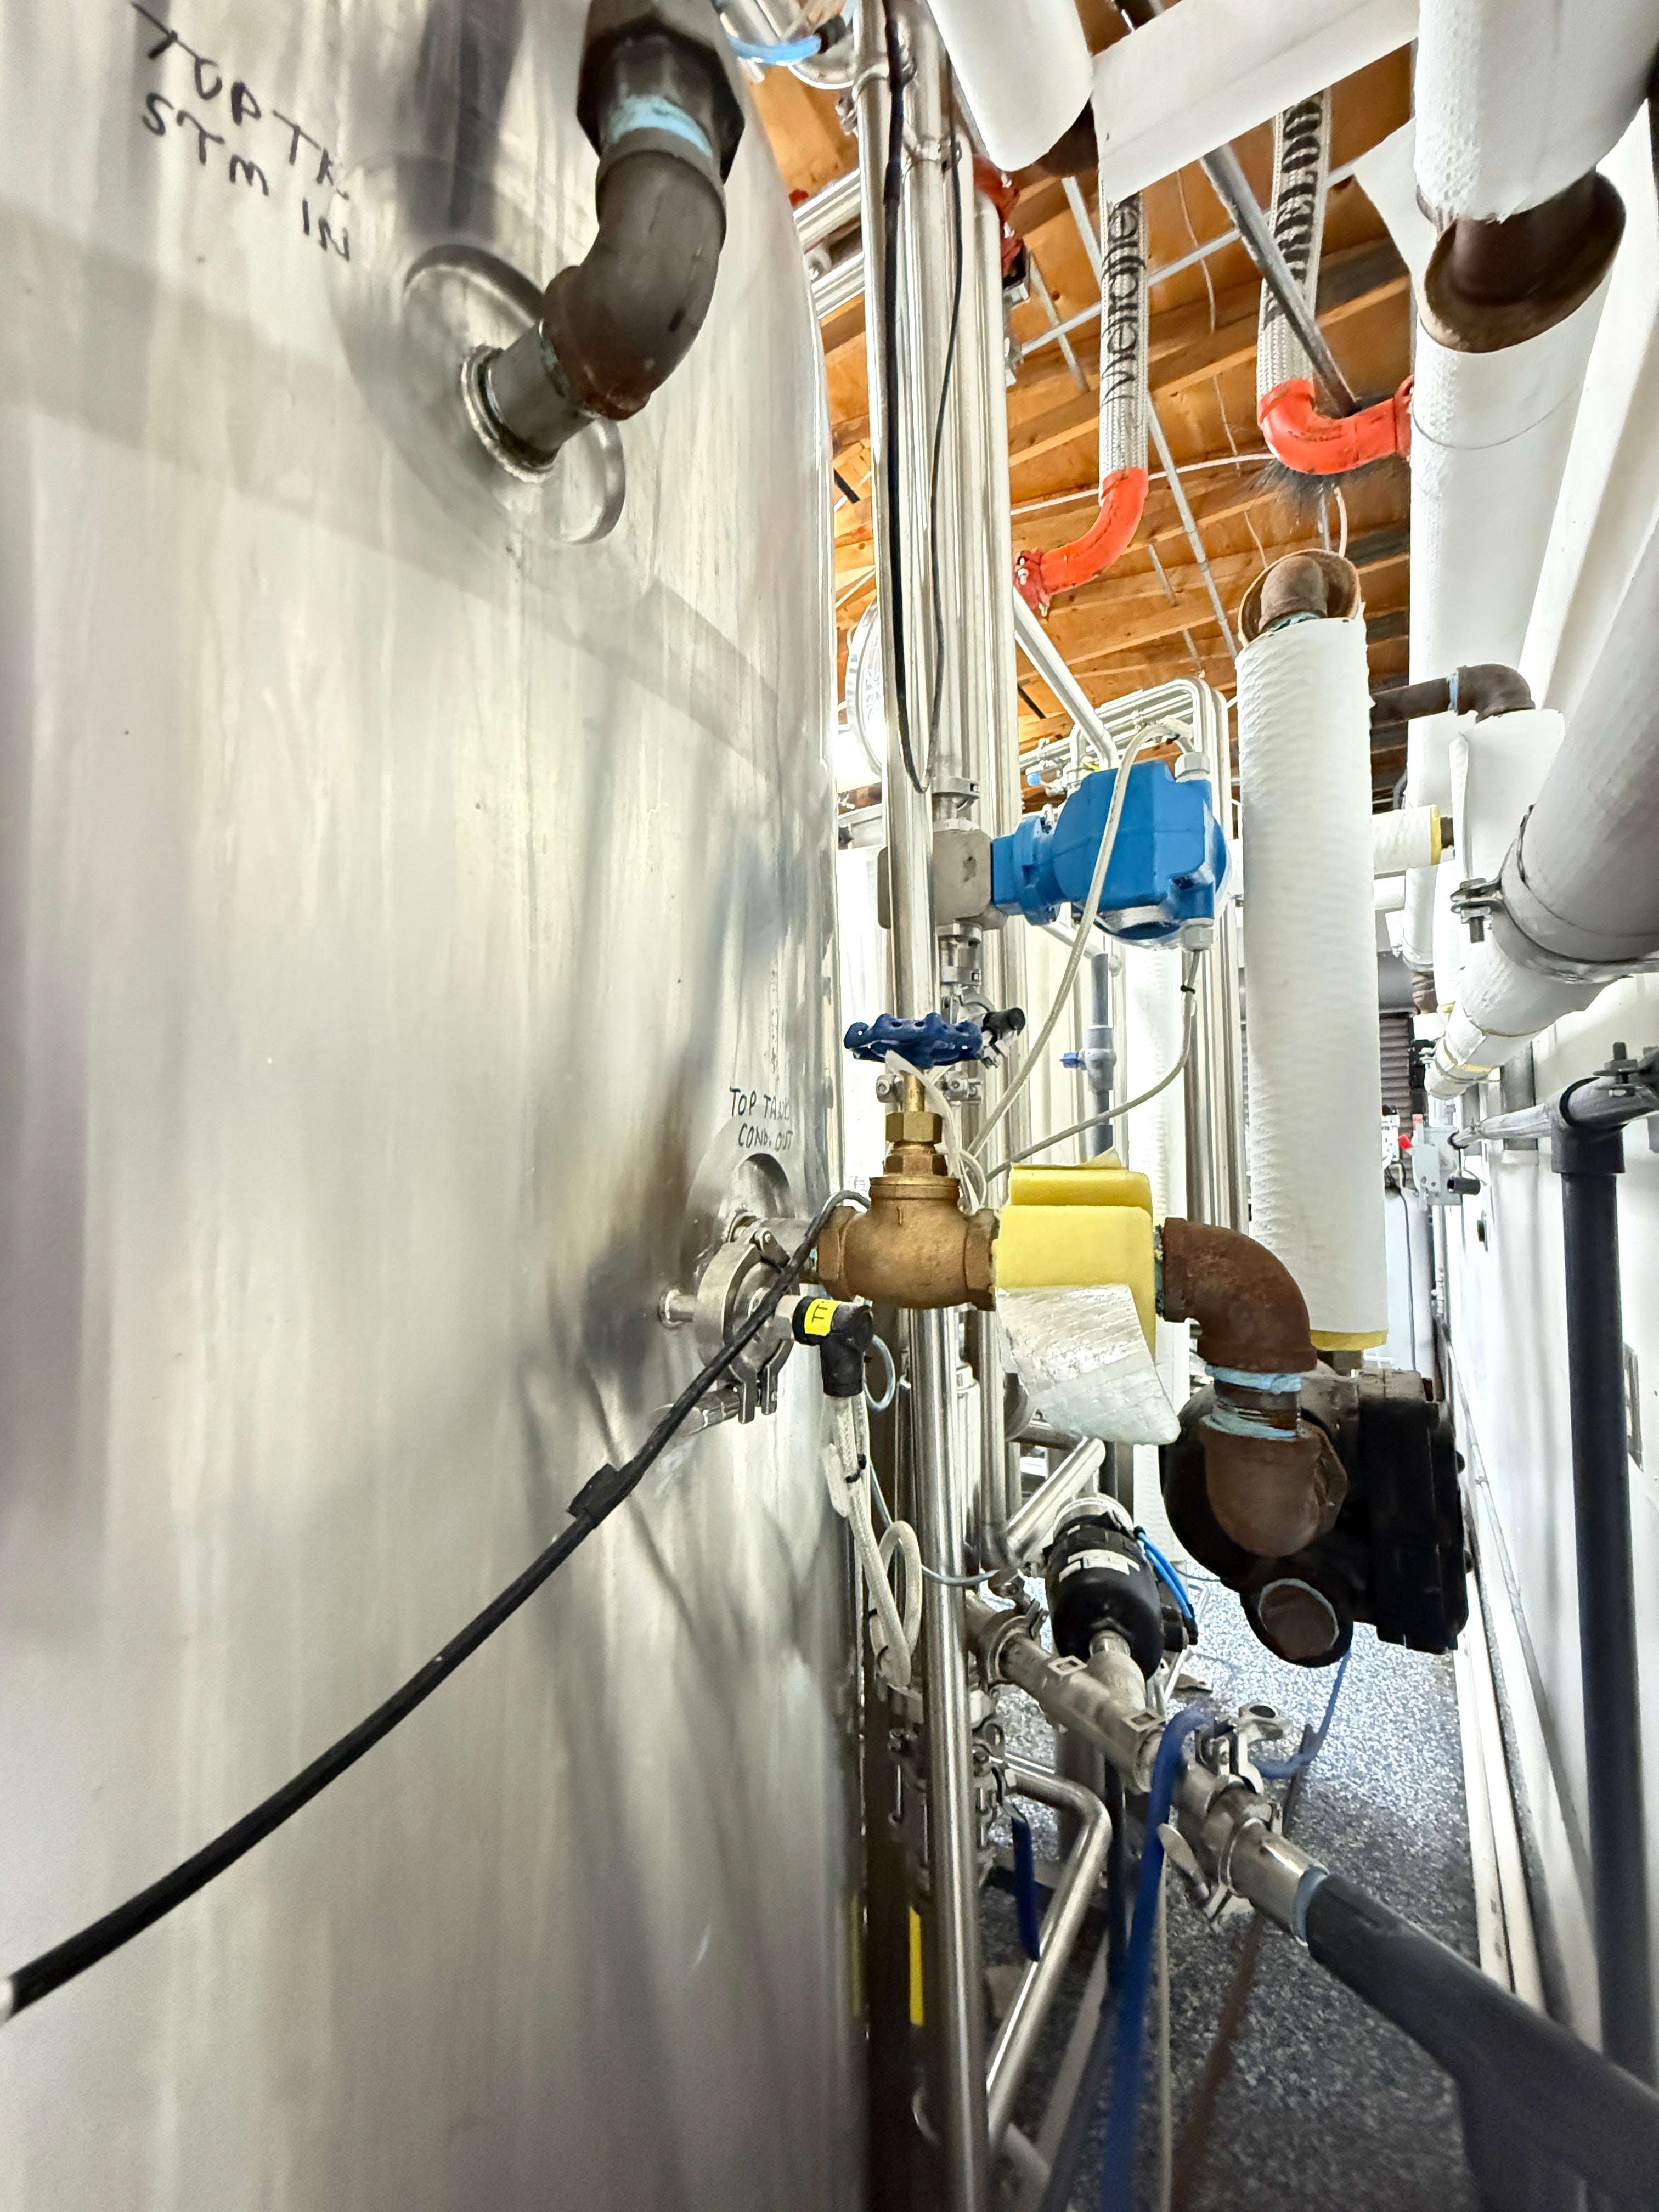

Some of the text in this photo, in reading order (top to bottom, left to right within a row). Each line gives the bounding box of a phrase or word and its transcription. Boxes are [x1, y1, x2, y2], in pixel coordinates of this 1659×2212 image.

[131, 2, 262, 125] TOP
[142, 93, 350, 262] STM IN
[730, 1086, 757, 1117] TOP
